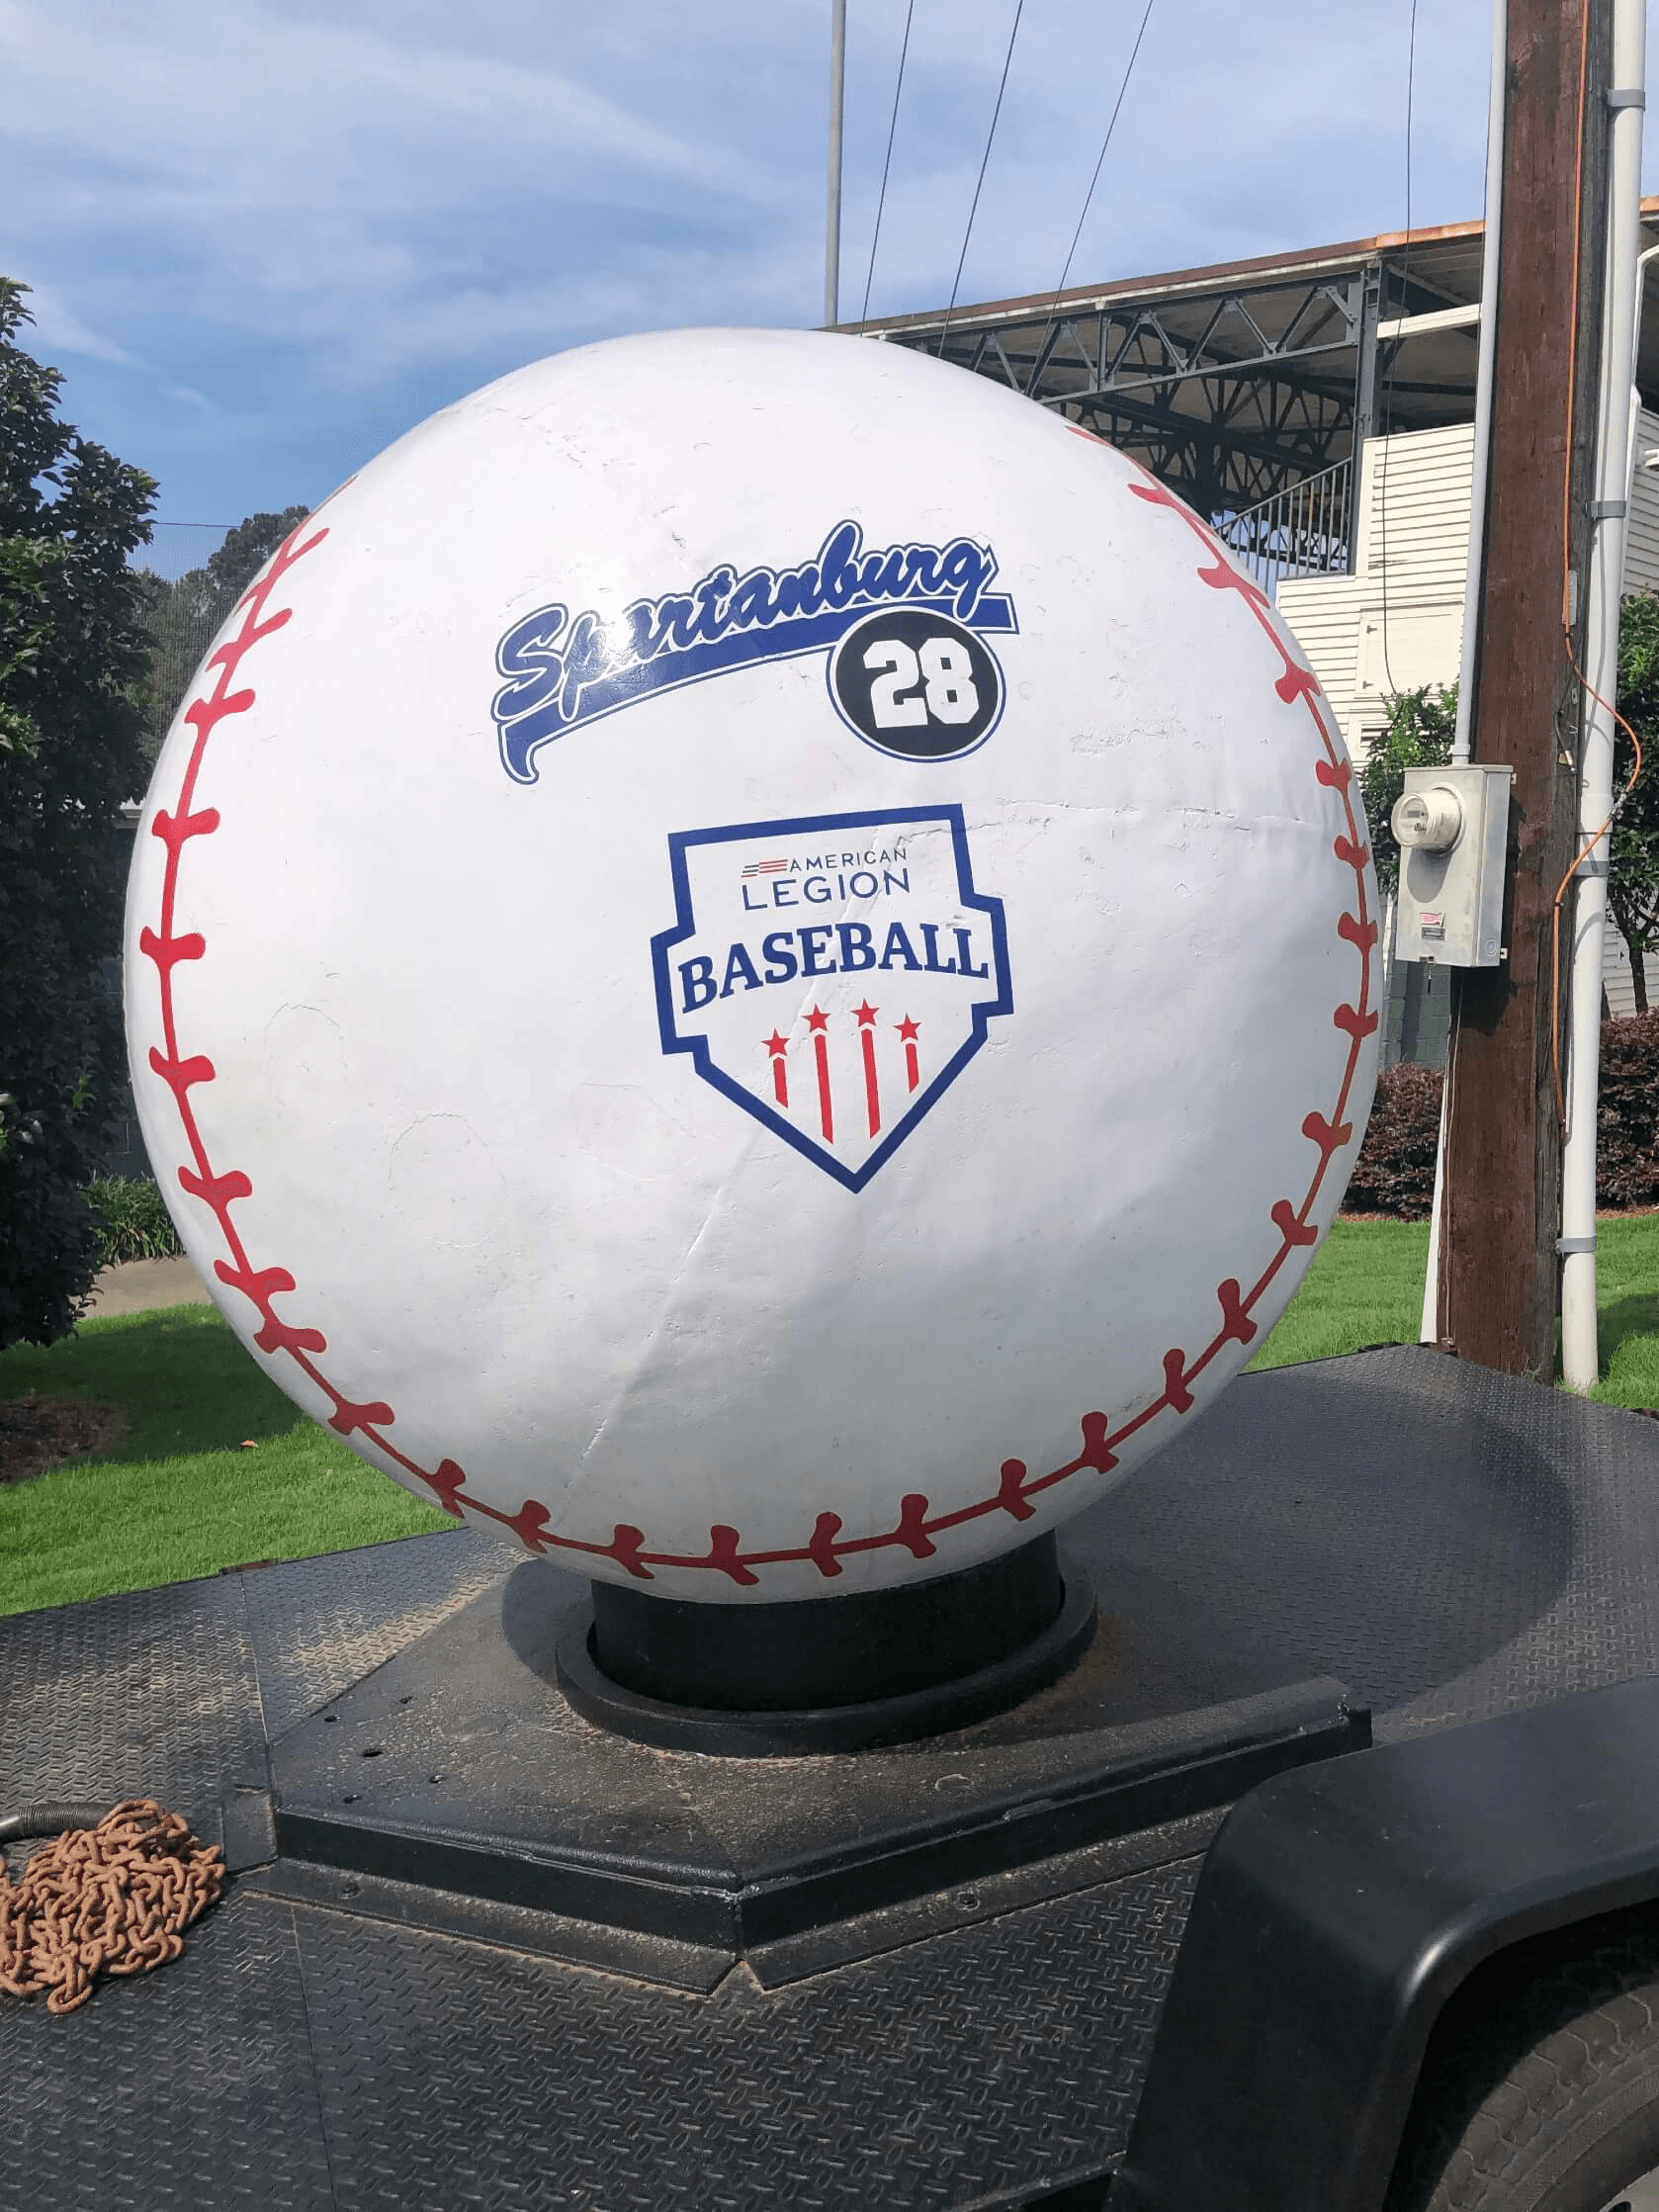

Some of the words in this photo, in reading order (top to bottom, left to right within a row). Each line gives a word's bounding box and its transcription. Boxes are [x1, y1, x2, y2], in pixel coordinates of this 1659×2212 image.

[491, 519, 1002, 727] Spartanburg
[863, 637, 981, 730] 28
[742, 867, 912, 911] LEGION
[789, 846, 909, 873] AMERICAN
[677, 921, 990, 1015] BASEBALL
